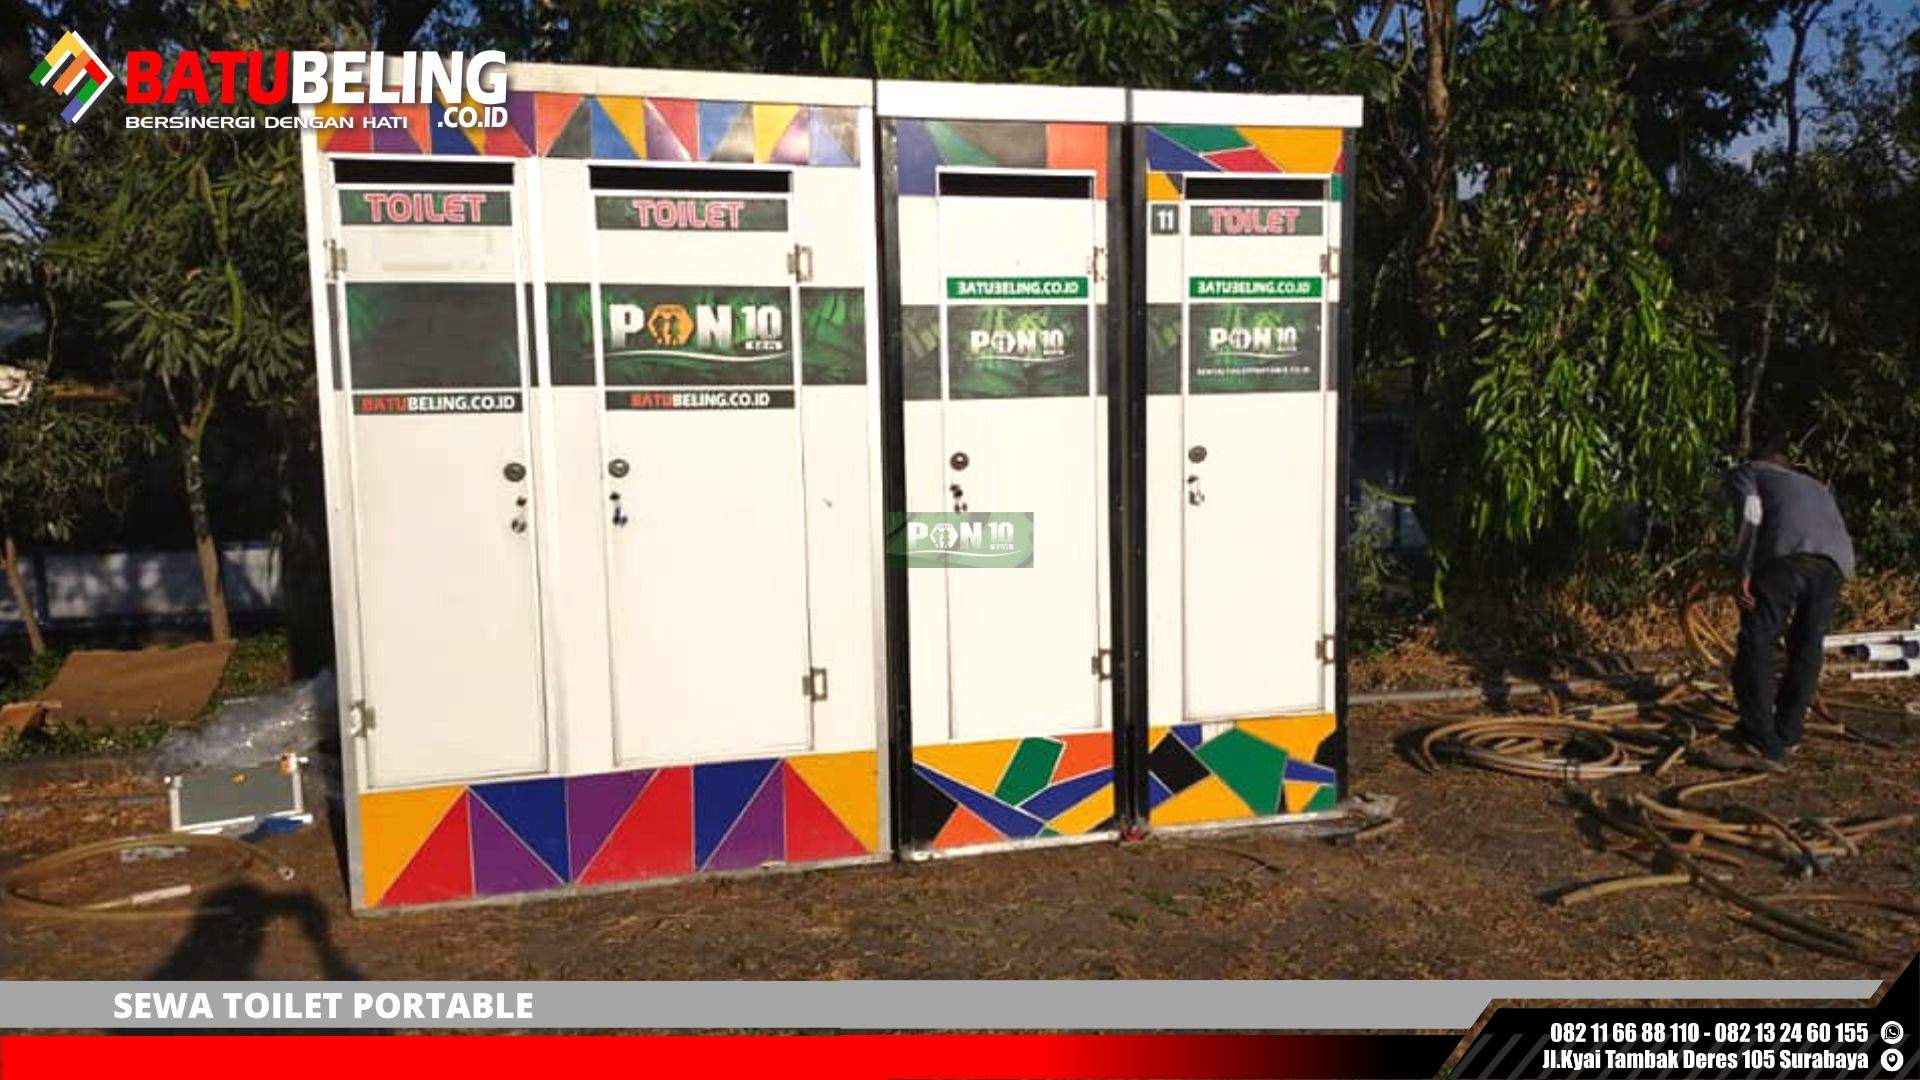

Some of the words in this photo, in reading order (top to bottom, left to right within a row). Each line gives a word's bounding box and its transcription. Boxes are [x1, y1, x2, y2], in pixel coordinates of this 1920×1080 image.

[364, 192, 487, 223] TOILET
[632, 199, 745, 229] TOILET
[1157, 209, 1175, 231] 11
[1208, 206, 1300, 234] TOILET
[740, 305, 783, 340] 10
[1041, 328, 1064, 351] 10
[1276, 326, 1297, 348] 10
[360, 395, 516, 412] BATUBELING.CO.ID
[630, 392, 771, 409] BATUBELING.CO.ID
